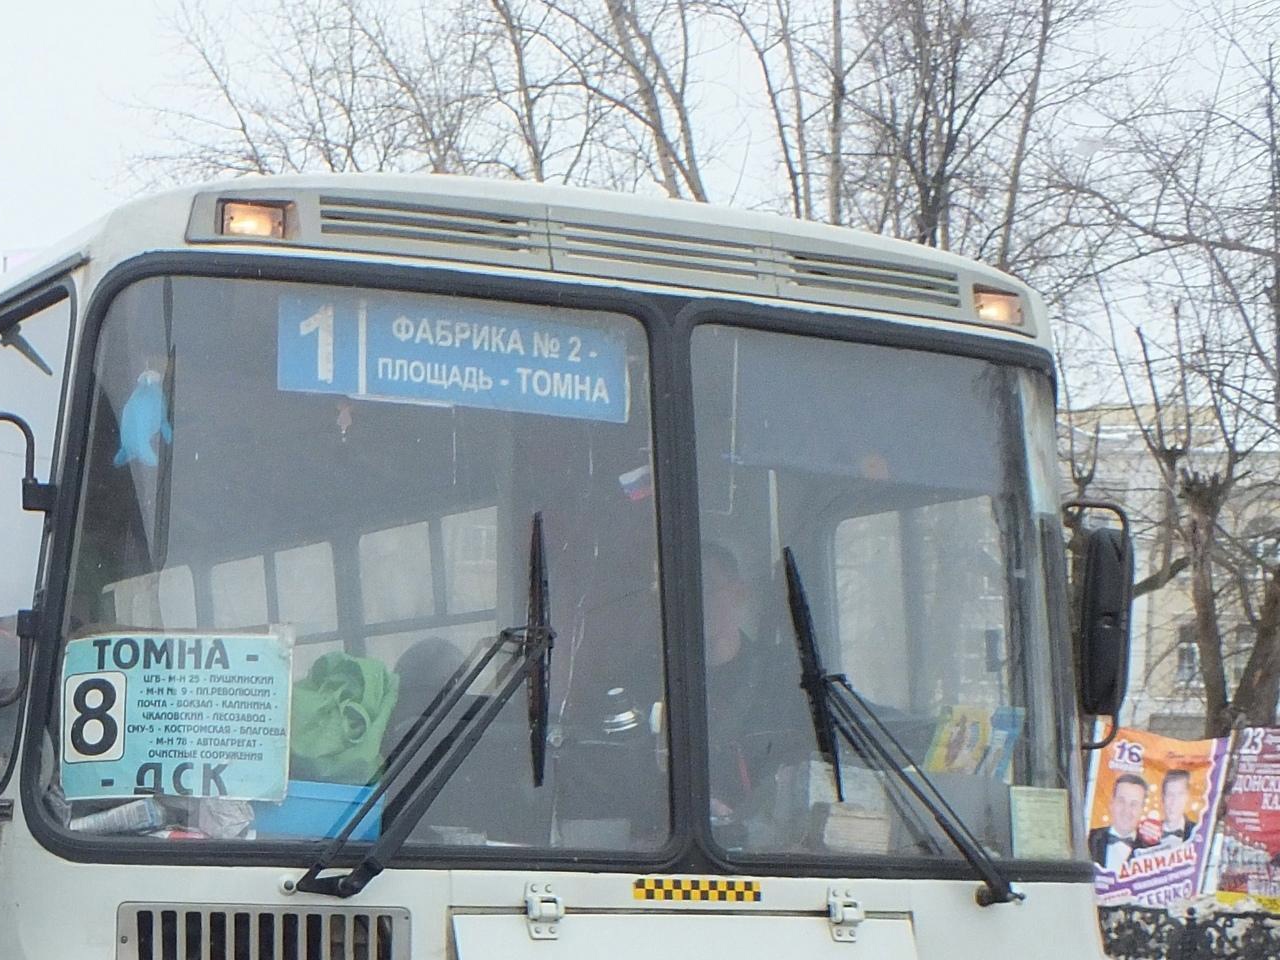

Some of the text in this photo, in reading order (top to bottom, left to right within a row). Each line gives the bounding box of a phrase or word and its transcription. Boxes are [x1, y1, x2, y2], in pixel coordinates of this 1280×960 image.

[299, 303, 334, 383] 1
[392, 315, 524, 356] ФАБРИКА
[533, 331, 560, 359] №
[568, 336, 581, 362] 2
[378, 357, 493, 392] ПЛОЩАДЬ
[516, 366, 610, 404] ТОМНА
[93, 638, 230, 670] ТОМНА
[71, 678, 117, 756] 8
[137, 700, 167, 708] ПОЧТА
[177, 700, 212, 708] ВОКЗАЛ
[222, 701, 271, 709] КАЛИНИНА
[142, 712, 203, 721] ЧКАЛОВСКИЙ
[212, 713, 265, 723] ЛЕСОЗАВОД
[127, 725, 154, 733] СМУ-5
[164, 725, 231, 734] КОСТРОМСКАЯ
[239, 727, 287, 736] БЛАГОЕВА
[197, 739, 257, 748] АВТОАГРЕГАТ
[1240, 727, 1265, 754] 23
[149, 751, 263, 760] ОЧИСТНЫЕ СООРУЖЕНИЯ
[1116, 741, 1142, 763] 16
[133, 762, 228, 796] ДСК
